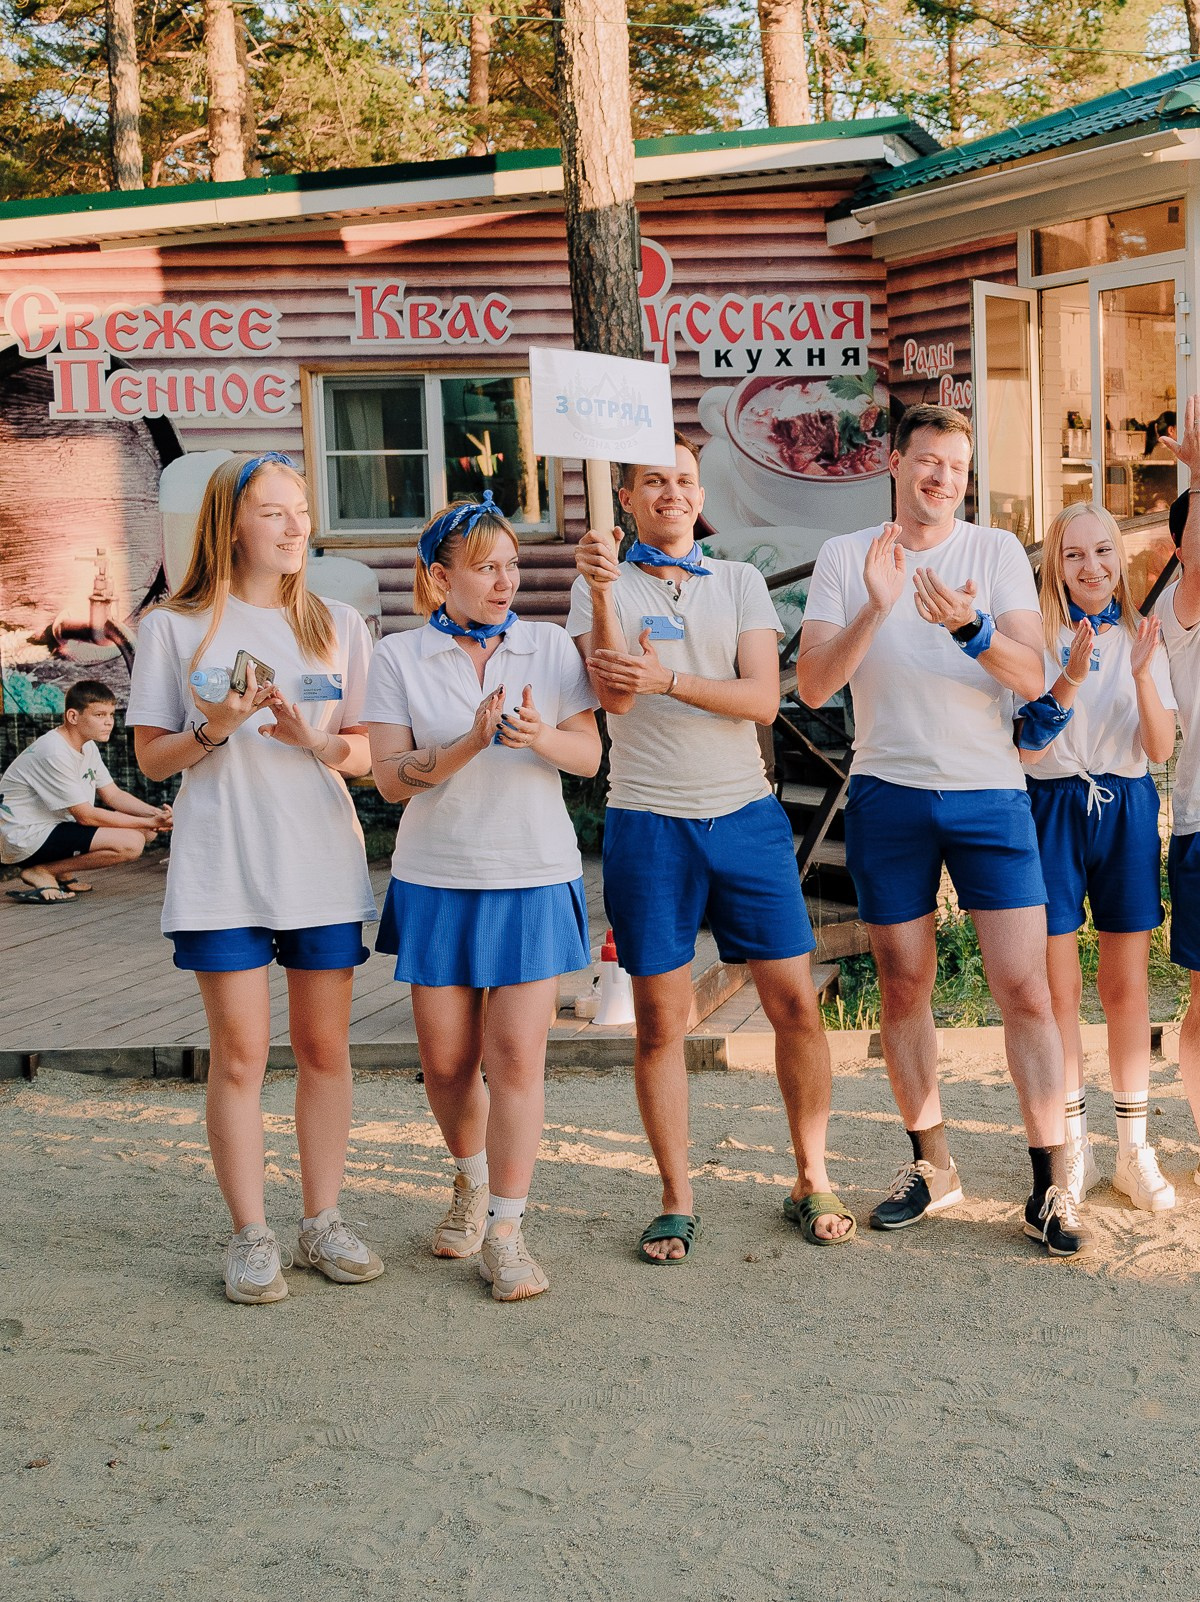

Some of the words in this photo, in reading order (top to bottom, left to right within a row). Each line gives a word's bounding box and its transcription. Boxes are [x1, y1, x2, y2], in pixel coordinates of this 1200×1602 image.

[353, 283, 509, 341] Квас
[713, 346, 861, 374] кухня
[904, 342, 953, 373] Рады
[555, 395, 569, 414] 3
[575, 397, 653, 429] ОТРЯД
